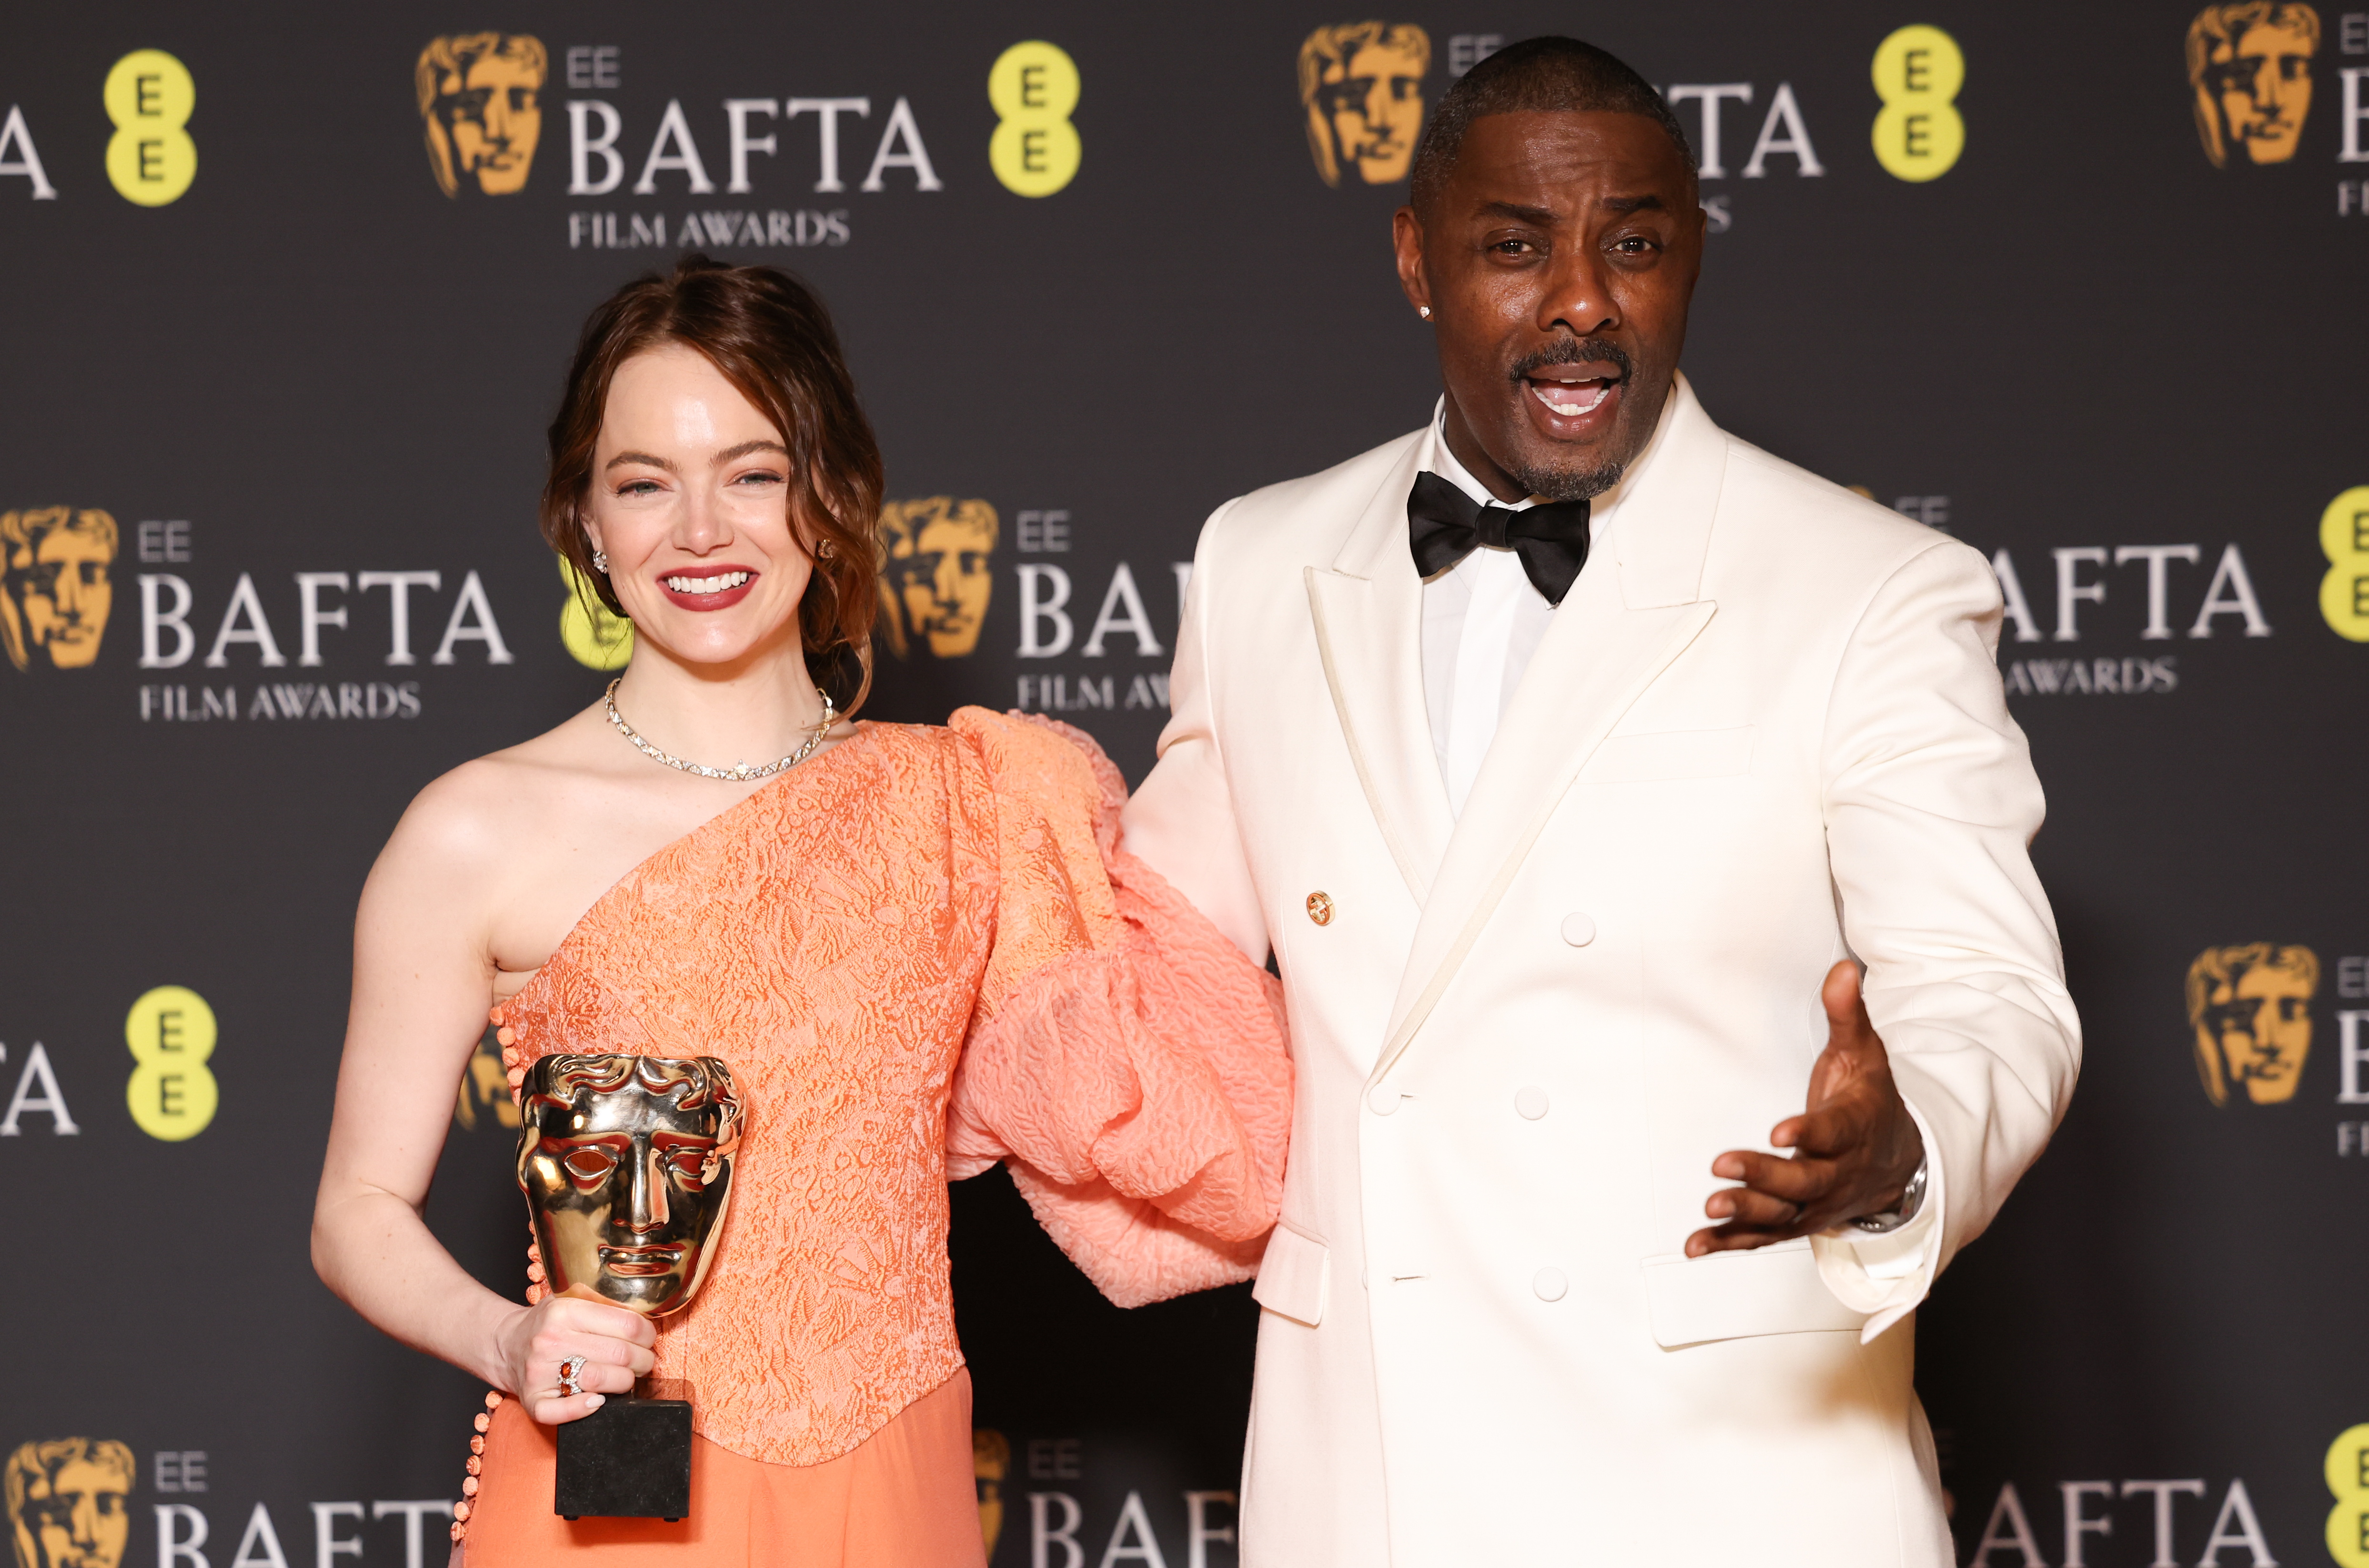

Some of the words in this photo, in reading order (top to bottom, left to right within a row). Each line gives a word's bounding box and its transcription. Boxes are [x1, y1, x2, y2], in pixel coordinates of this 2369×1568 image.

[2339, 13, 2369, 55] E
[566, 46, 619, 89] EE
[566, 97, 942, 195] BAFTA
[1653, 83, 1824, 179] TA
[568, 212, 666, 248] FILM
[678, 210, 850, 247] AWARDS
[138, 520, 191, 563] EE
[1017, 510, 1070, 553] EE
[138, 571, 513, 668] BAFTA
[1017, 674, 1115, 710] FILM
[2005, 657, 2177, 694] AWARDS
[140, 685, 238, 721] FILM
[250, 682, 422, 720] AWARDS
[2337, 956, 2369, 998] E
[154, 1451, 208, 1492] EE
[1027, 1439, 1080, 1479] EE
[1953, 1478, 2280, 1568] AFTA
